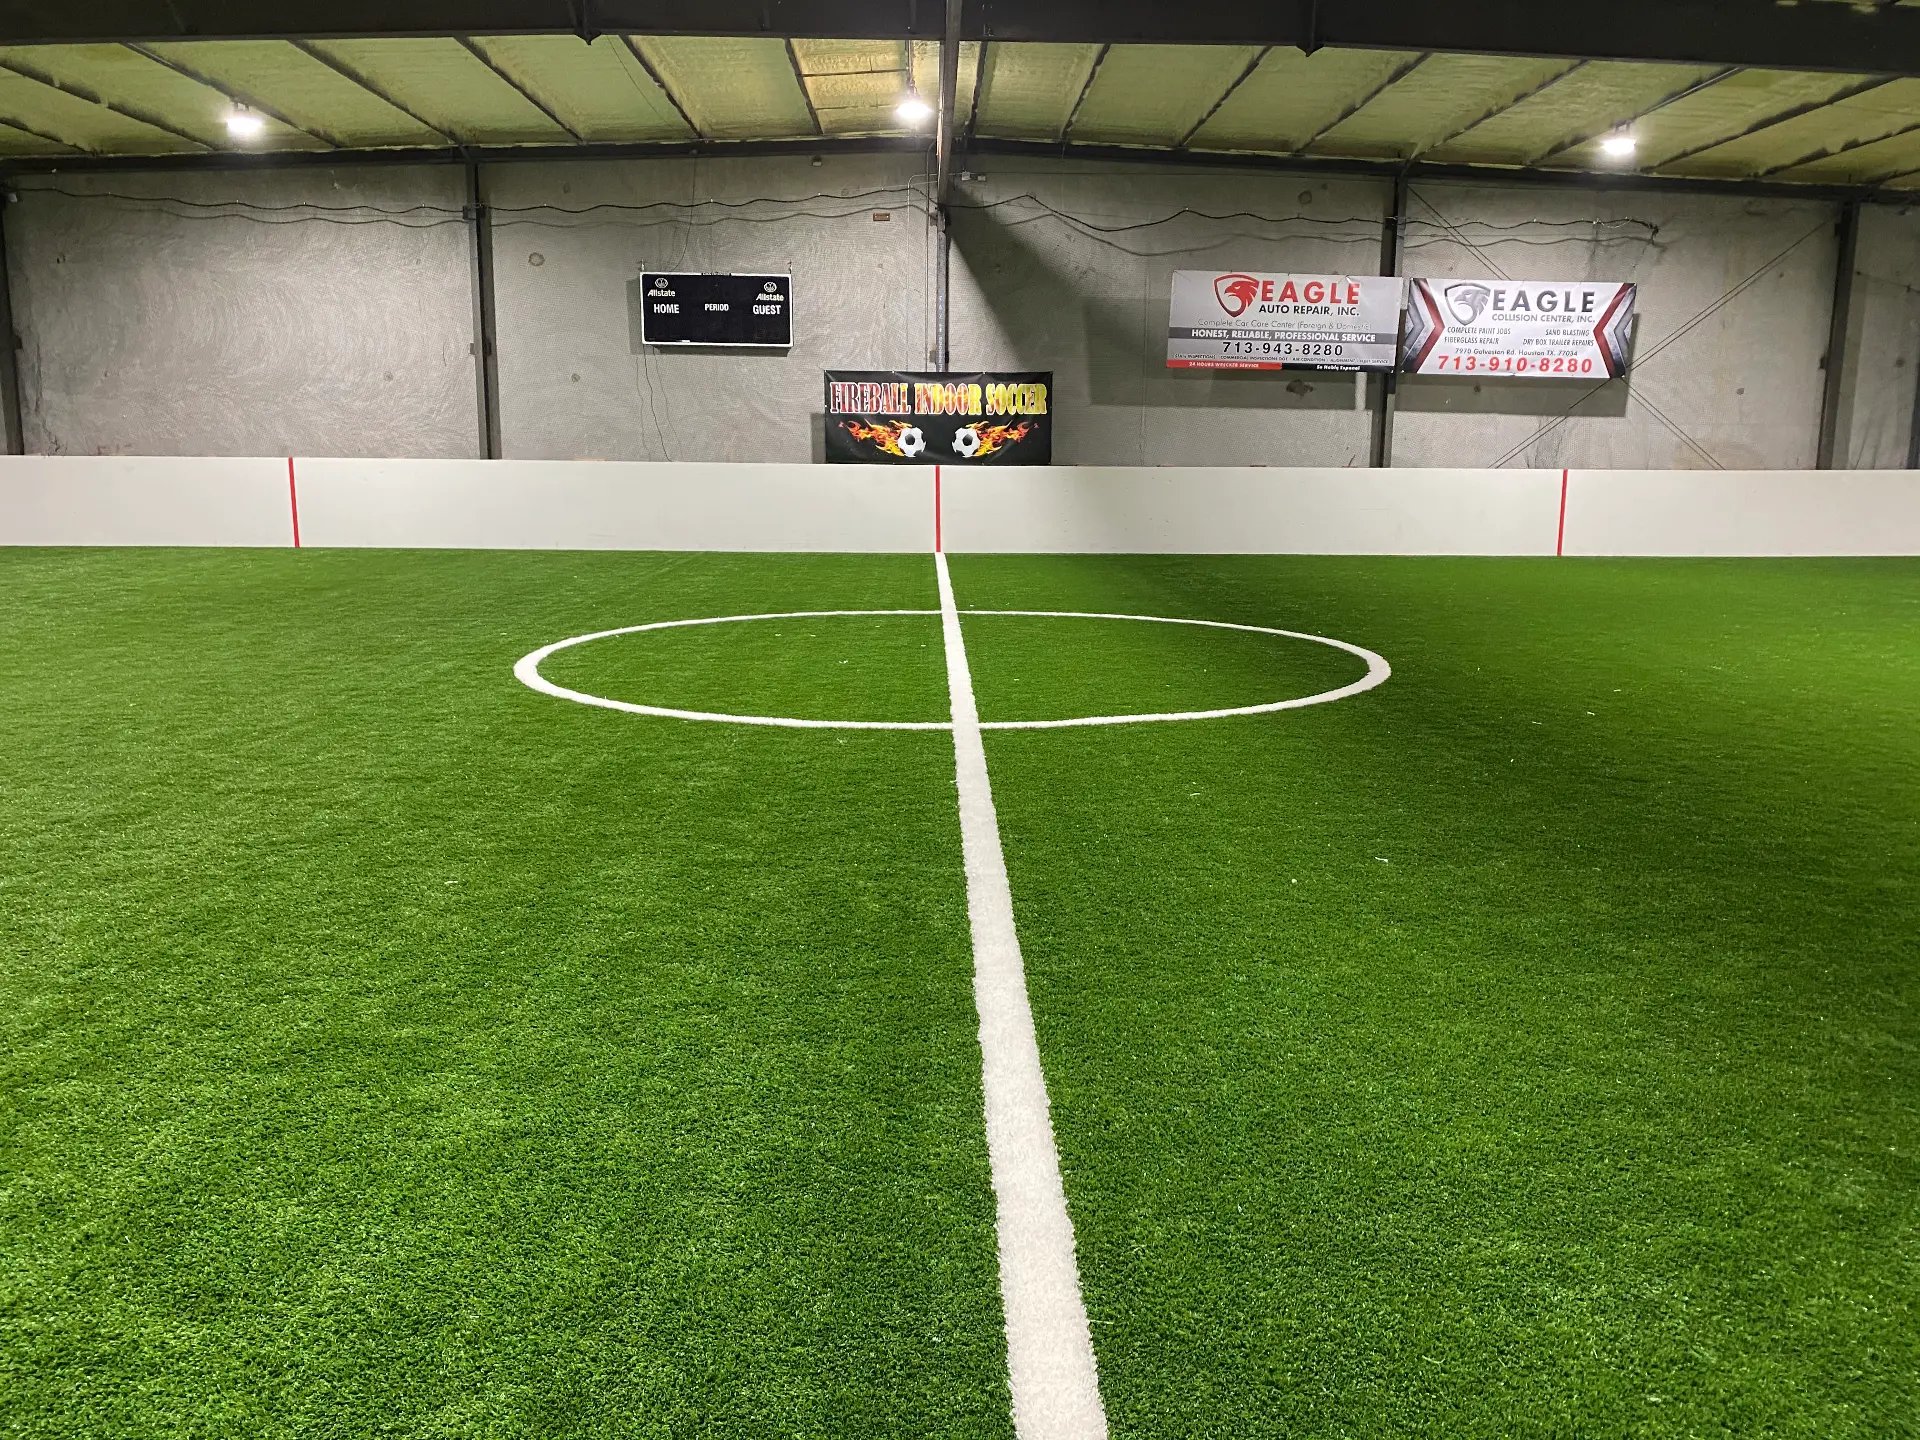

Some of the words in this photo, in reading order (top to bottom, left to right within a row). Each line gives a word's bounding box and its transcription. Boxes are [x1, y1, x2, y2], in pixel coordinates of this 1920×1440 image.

[647, 289, 676, 297] Allstate
[756, 292, 785, 301] Allstate
[1261, 280, 1360, 305] EAGLE
[1492, 289, 1595, 313] EAGLE
[653, 303, 680, 313] HOME
[704, 303, 729, 311] PERIOD
[753, 305, 781, 315] GUEST
[1259, 304, 1290, 314] AUTO
[1293, 305, 1334, 316] REPAIR,
[1337, 307, 1360, 316] INC.
[1492, 313, 1538, 322] COLLISION
[1540, 314, 1574, 324] CENTER,
[1576, 315, 1596, 323] INC.
[1197, 318, 1233, 327] Complete
[1236, 319, 1249, 327] Car
[1251, 319, 1269, 327] Care
[1272, 320, 1295, 328] Center
[1329, 322, 1334, 330] &
[1191, 329, 1230, 339] HONEST,
[1231, 330, 1272, 340] RELIABLE,
[1275, 331, 1340, 341] PROFESSIONAL
[1341, 333, 1376, 342] SERVICE
[1447, 326, 1477, 334] COMPLETE
[1479, 327, 1496, 335] PAINT
[1497, 327, 1511, 335] JOBS
[1563, 329, 1590, 337] BLASTING
[1444, 336, 1478, 344] FIBERGLASS
[1479, 337, 1500, 345] REPAIR
[1536, 338, 1548, 346] BOX
[1572, 339, 1594, 347] REPAIRS
[1222, 341, 1344, 356] 713-943-8280
[1437, 355, 1593, 373] 713-910-8280
[829, 381, 912, 415] FIREBALL
[914, 382, 982, 415] INDOOR
[986, 383, 1048, 416] SOCCER
